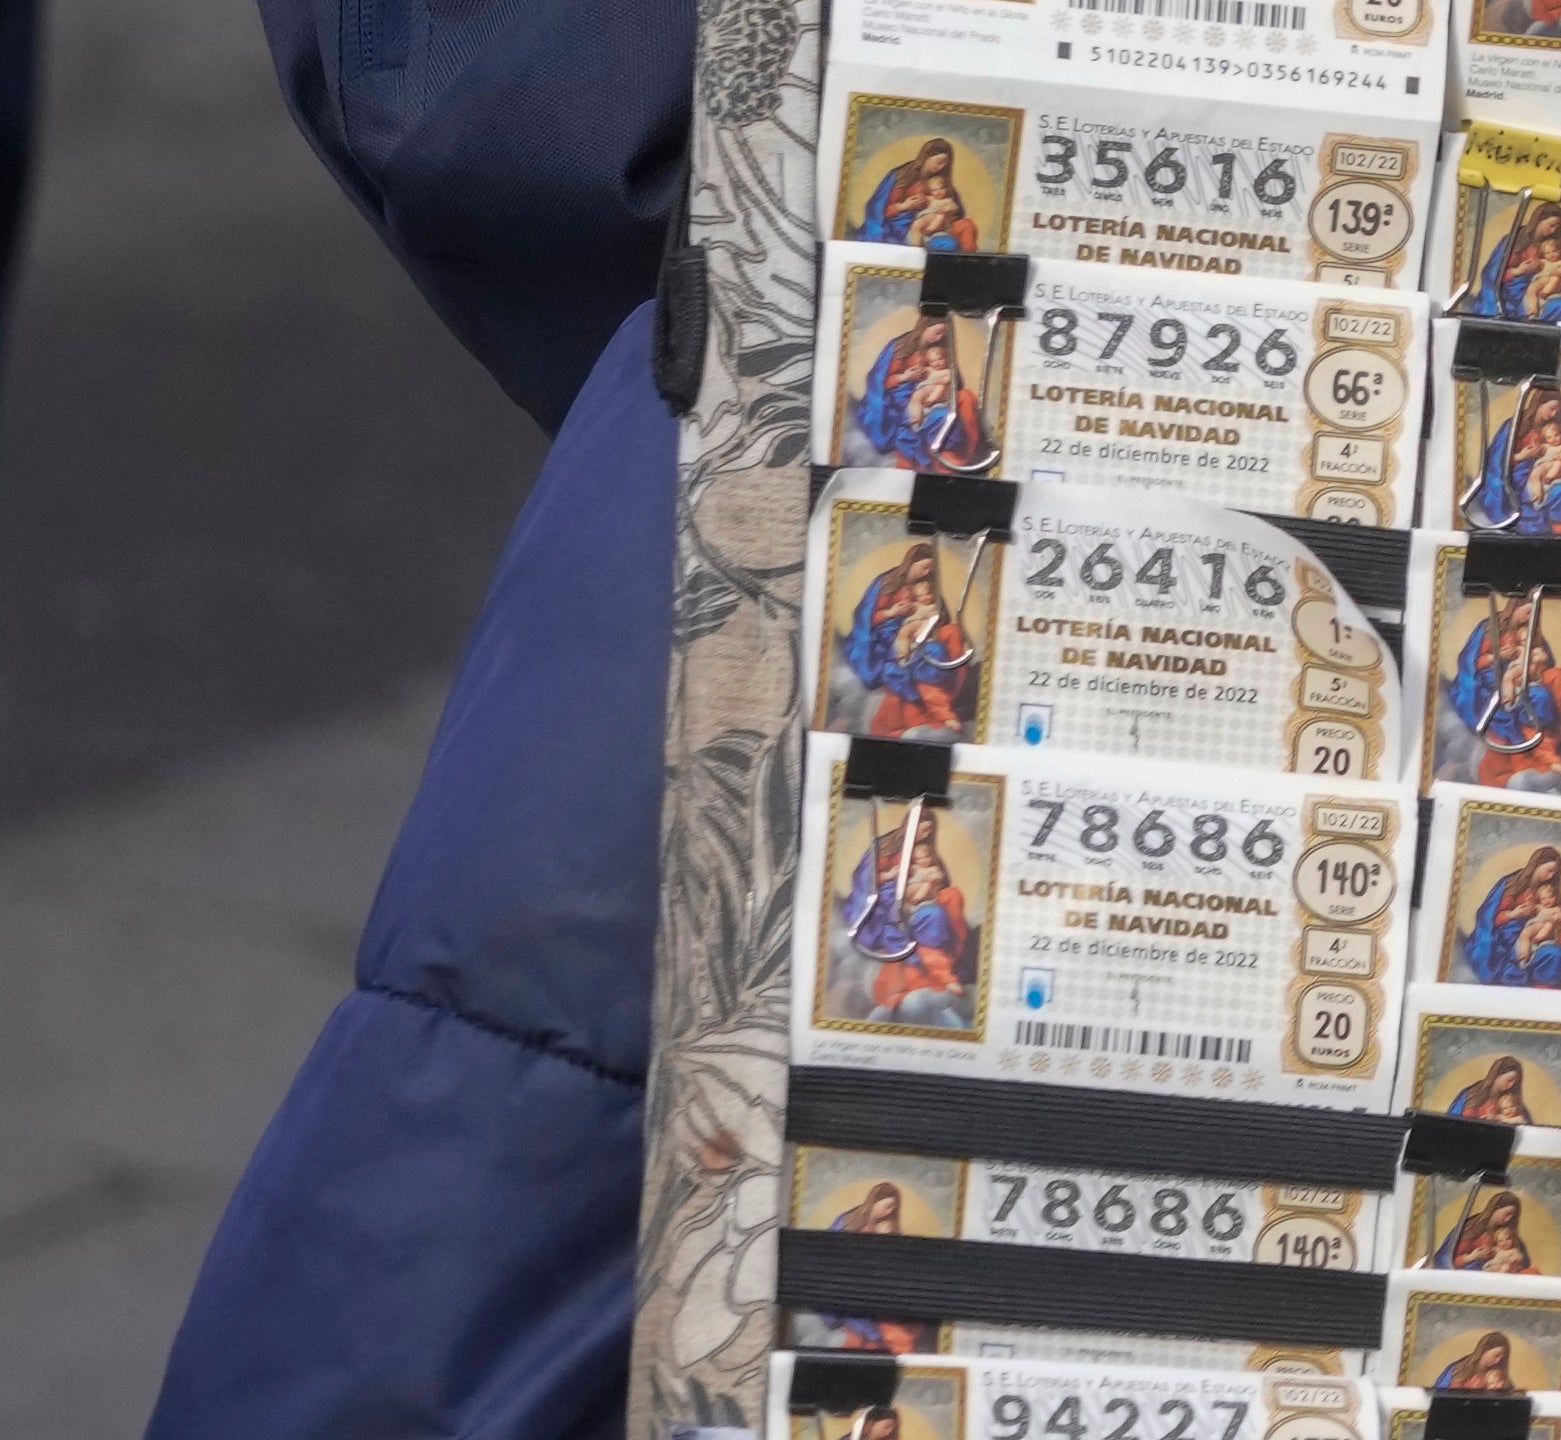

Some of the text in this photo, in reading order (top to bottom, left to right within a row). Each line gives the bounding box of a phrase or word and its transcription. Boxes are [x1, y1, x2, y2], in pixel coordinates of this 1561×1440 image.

[1036, 135, 1298, 206] 35616
[1039, 308, 1298, 376] 87926
[1334, 318, 1391, 336] 102/22
[1031, 384, 1289, 422] LOTERÍA NACIONAL
[1075, 416, 1241, 445] DE NAVIDAD
[1026, 539, 1286, 606] 26416
[1027, 800, 1285, 867] 78686
[1018, 880, 1278, 916] LOTERÍA NACIONAL
[1064, 912, 1229, 939] DE NAVIDAD
[1314, 1012, 1350, 1040] 20
[990, 1176, 1243, 1240] 78686
[993, 1394, 1251, 1440] 94227
